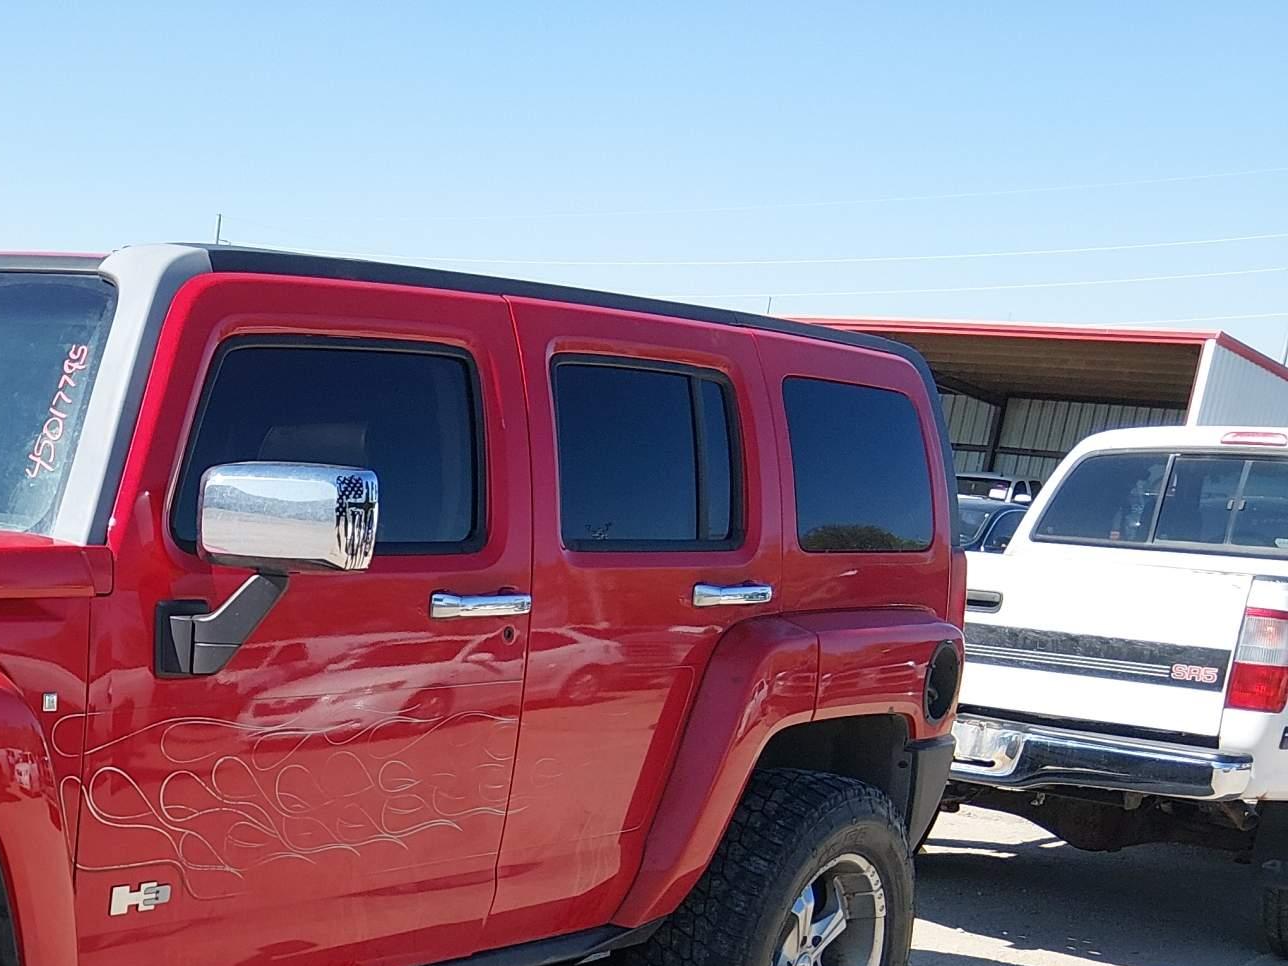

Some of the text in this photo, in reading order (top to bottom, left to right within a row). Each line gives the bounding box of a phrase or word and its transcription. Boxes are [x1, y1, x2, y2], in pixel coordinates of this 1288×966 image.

[25, 344, 88, 478] 45017795
[1171, 664, 1219, 684] SR5
[110, 882, 172, 917] H3
